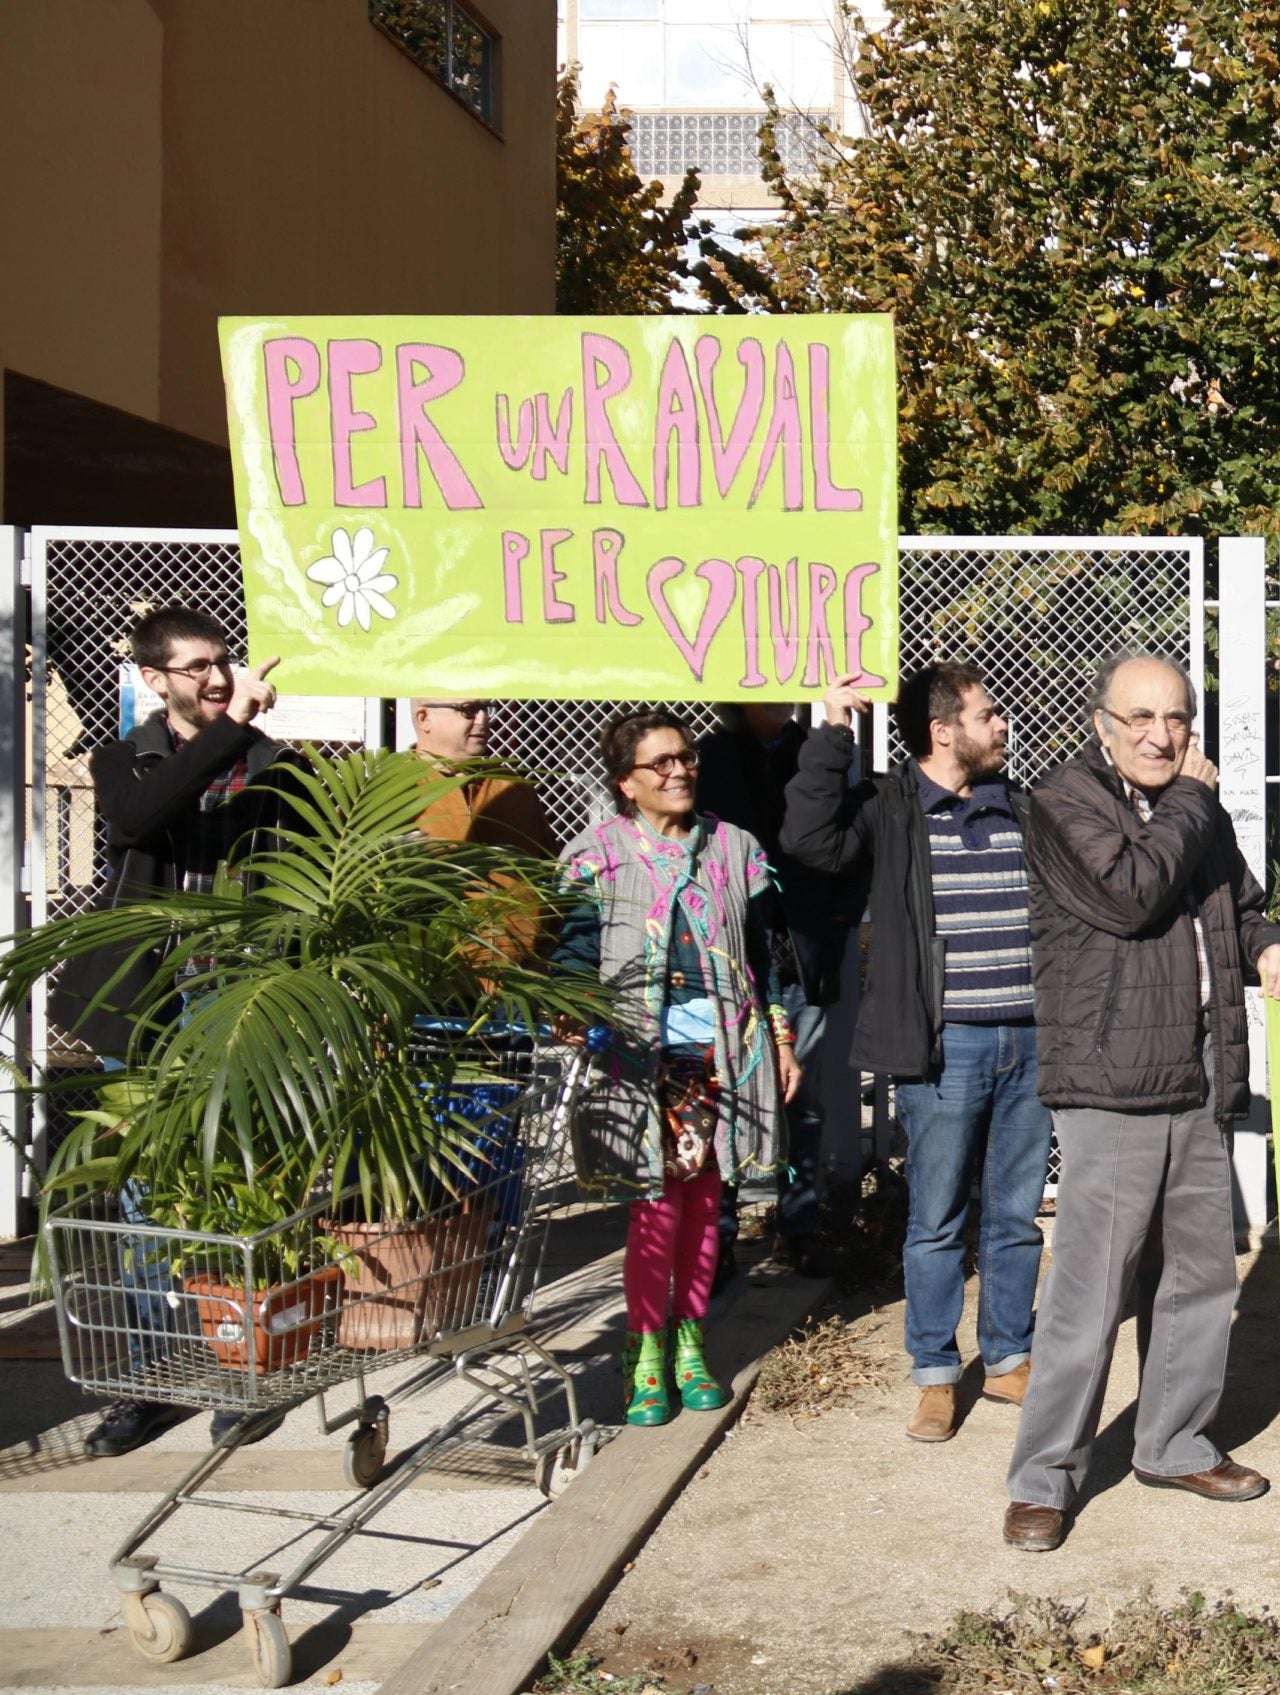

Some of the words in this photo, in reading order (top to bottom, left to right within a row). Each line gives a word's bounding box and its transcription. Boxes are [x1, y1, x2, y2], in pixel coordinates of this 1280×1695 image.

[263, 335, 484, 510] PER
[581, 332, 863, 511] RAVAL
[502, 528, 643, 627] PER
